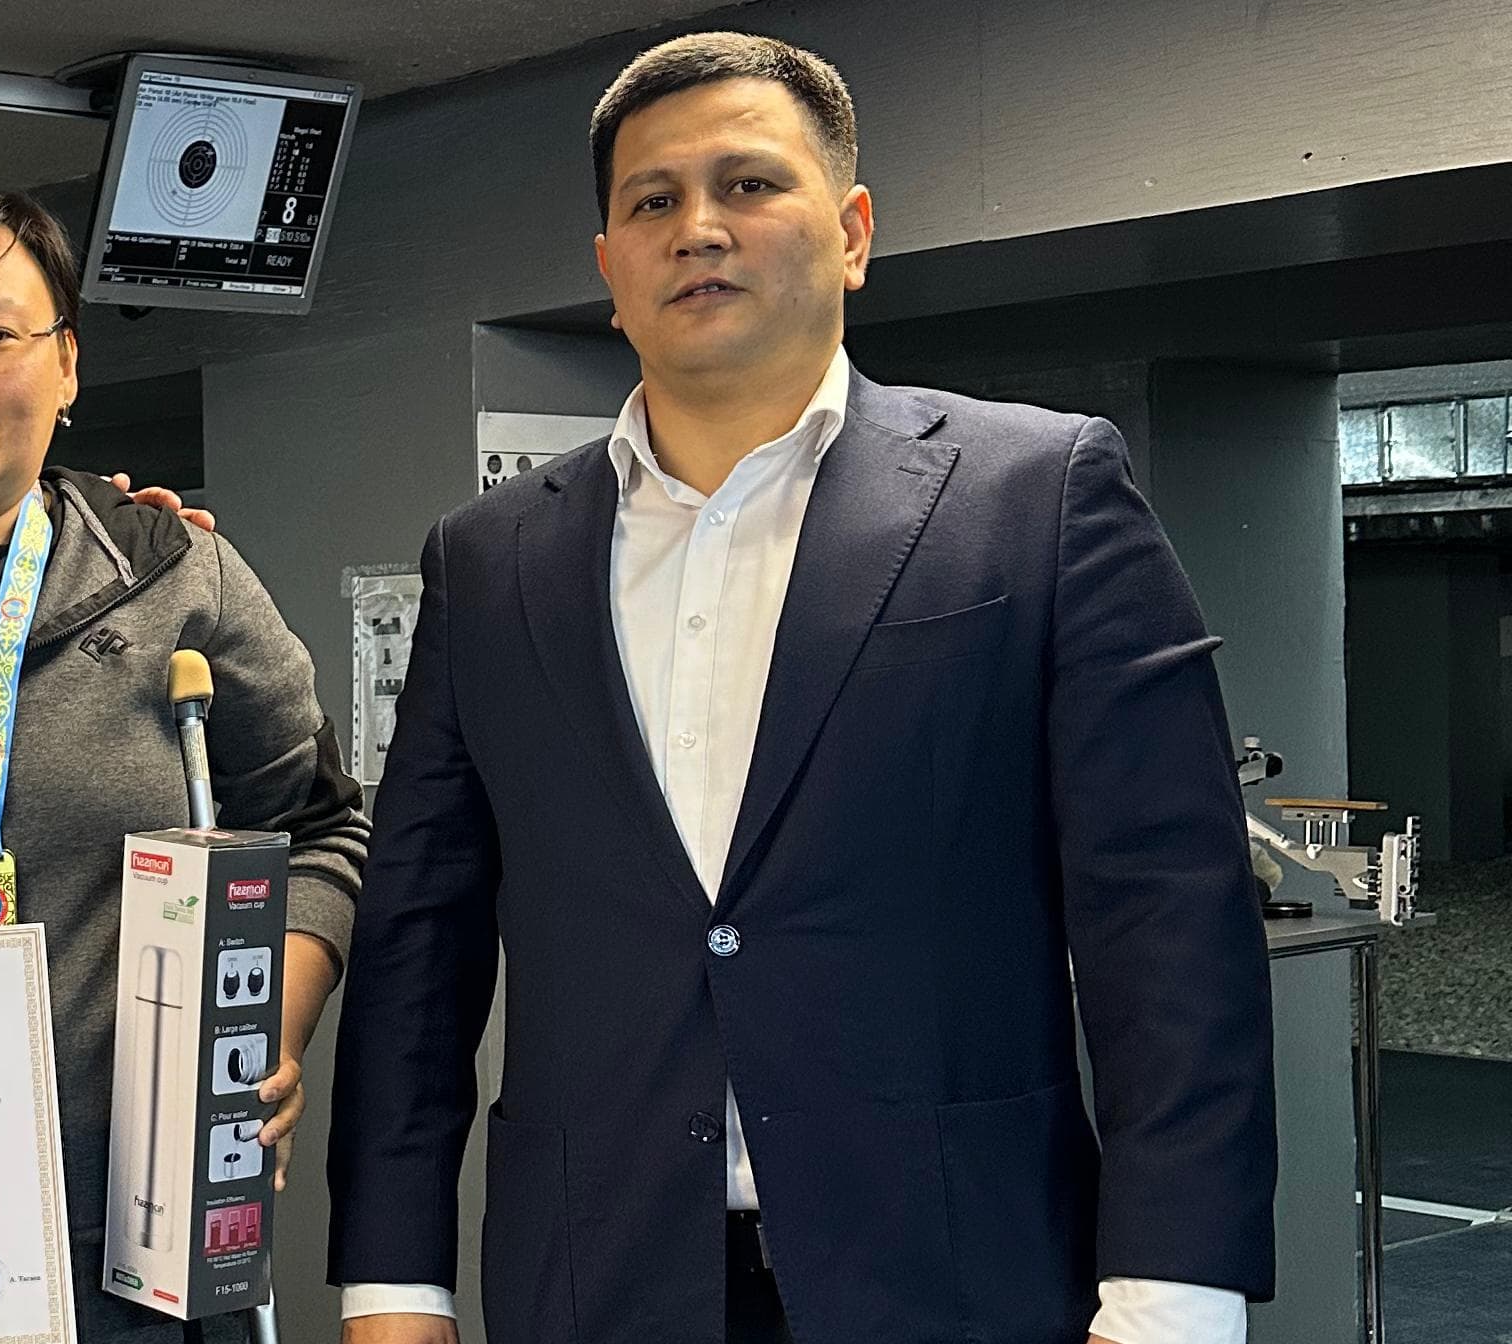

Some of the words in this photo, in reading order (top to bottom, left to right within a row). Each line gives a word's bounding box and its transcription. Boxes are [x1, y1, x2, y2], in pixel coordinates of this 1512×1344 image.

[282, 196, 297, 224] 8
[266, 254, 294, 268] READY
[133, 872, 158, 884] Vacuum
[228, 902, 254, 911] Vacuum
[222, 1025, 238, 1034] Large
